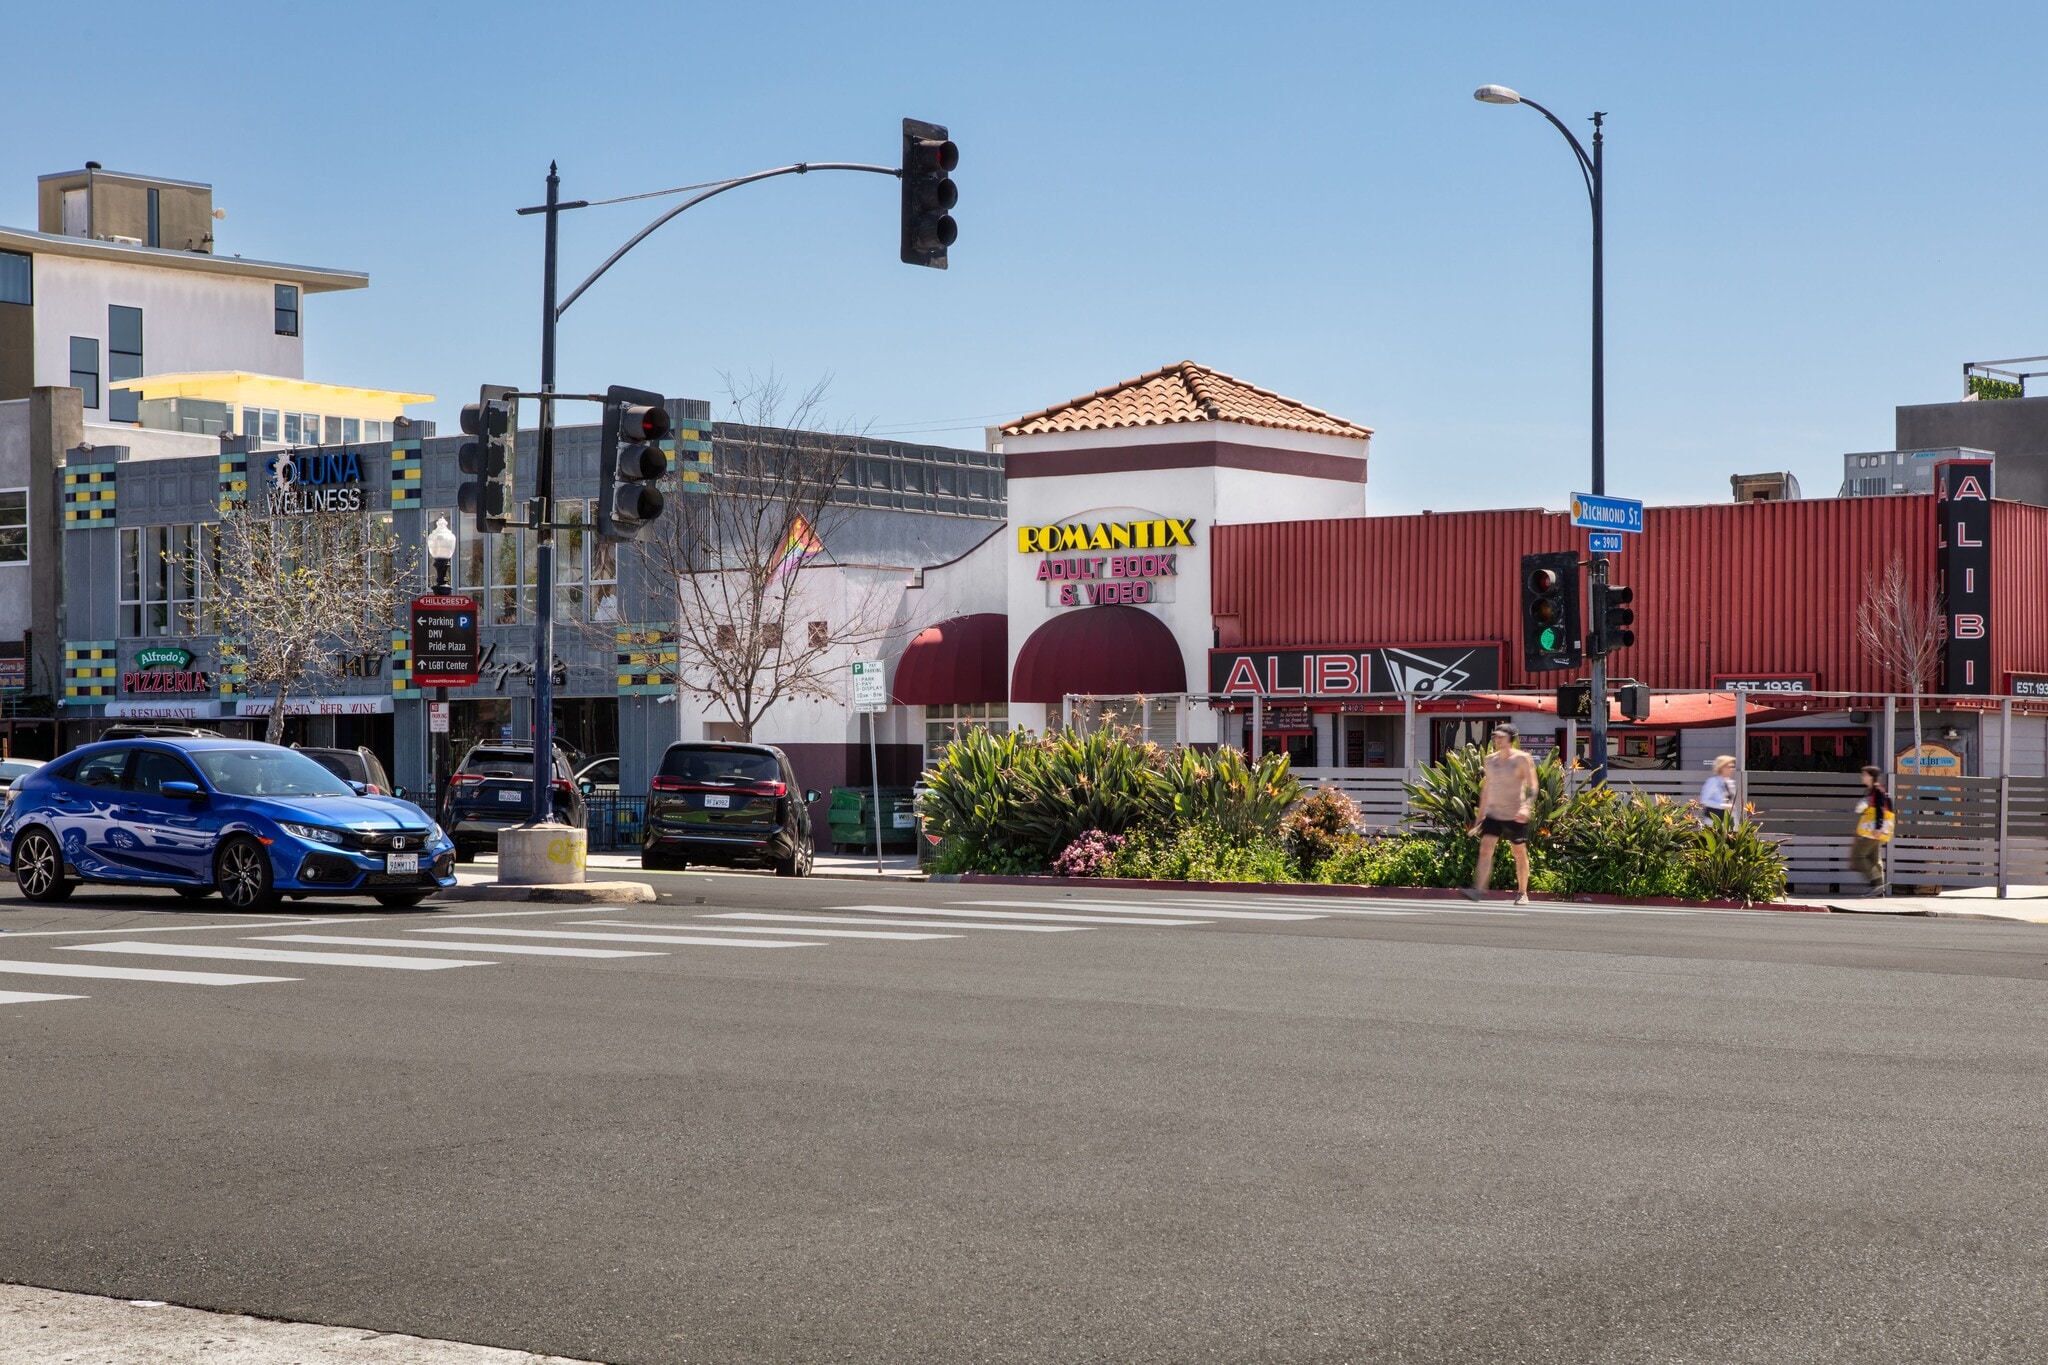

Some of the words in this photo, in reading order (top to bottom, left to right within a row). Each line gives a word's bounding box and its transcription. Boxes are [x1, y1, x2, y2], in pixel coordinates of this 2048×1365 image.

[266, 488, 360, 515] WELLNESS
[1018, 518, 1196, 553] ROMANTIX
[1602, 536, 1619, 549] 3900
[1037, 557, 1104, 581] ADULT
[1110, 553, 1175, 578] BOOK
[1937, 477, 1949, 686] ALIBI
[1953, 475, 1987, 685] ALIBI
[1060, 583, 1078, 606] &
[1084, 580, 1150, 605] VIDEO
[425, 597, 464, 605] HILLCREST
[428, 617, 454, 628] Parking
[428, 629, 443, 638] DMV
[428, 642, 447, 651] Pride
[448, 642, 466, 651] Plaza
[141, 651, 186, 665] Alfredo's
[336, 654, 384, 678] 1417
[428, 661, 444, 670] LGBT
[446, 661, 468, 670] Center
[123, 671, 206, 693] PIZZERIA
[1220, 653, 1371, 698] ALIBI
[1763, 681, 1804, 693] 1936
[2016, 681, 2035, 694] EST.
[283, 704, 311, 715] PASTA
[320, 703, 344, 714] BEER
[349, 702, 377, 713] WINE
